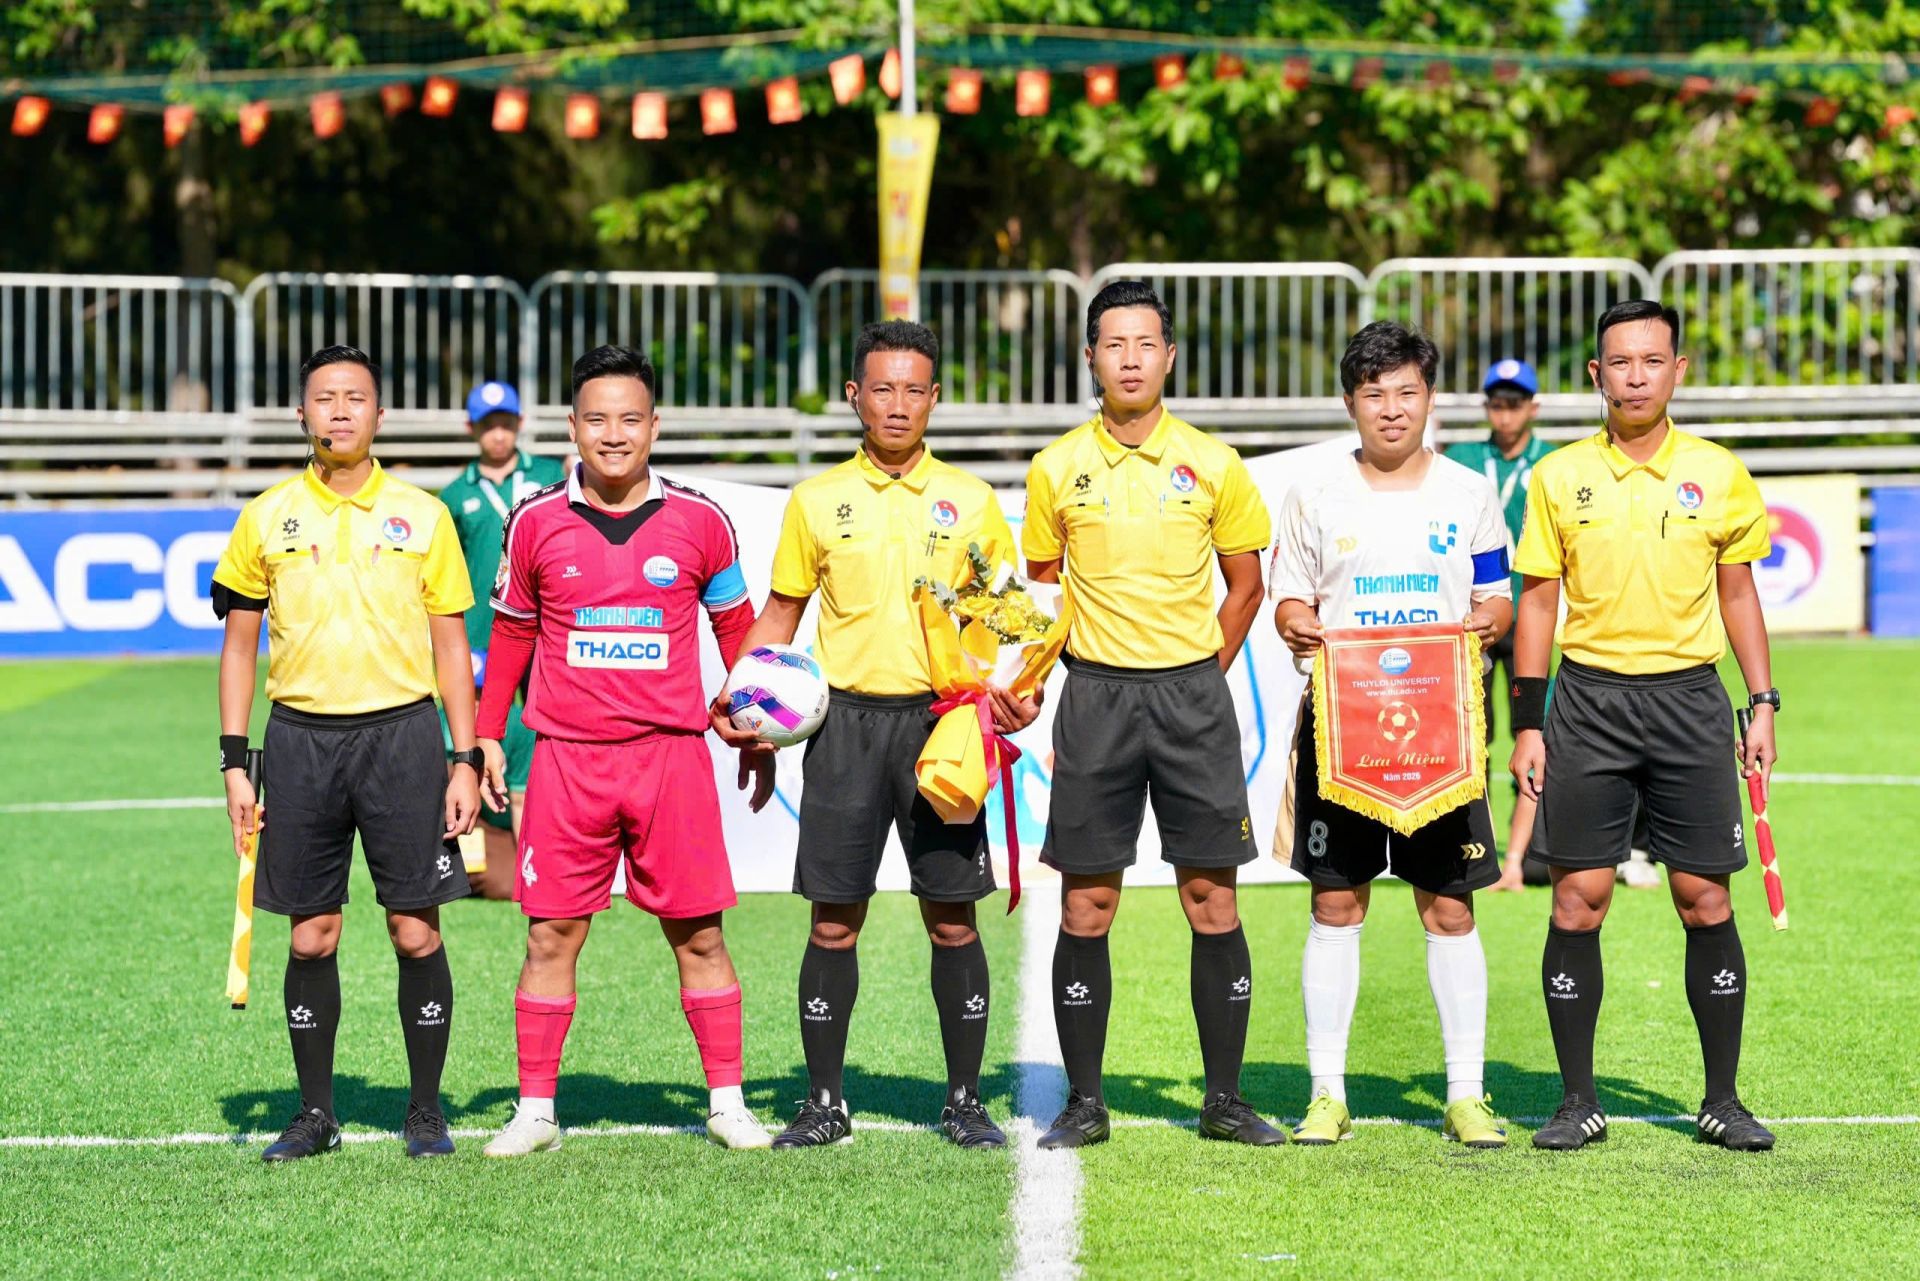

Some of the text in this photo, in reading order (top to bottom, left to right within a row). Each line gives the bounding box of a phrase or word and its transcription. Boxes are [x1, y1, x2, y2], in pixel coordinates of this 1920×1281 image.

[1353, 575, 1405, 595] THANH
[573, 607, 626, 626] THANH
[575, 641, 661, 659] THACO
[1391, 676, 1440, 686] UNIVERSITY
[1308, 820, 1329, 858] 8
[522, 846, 538, 887] 4
